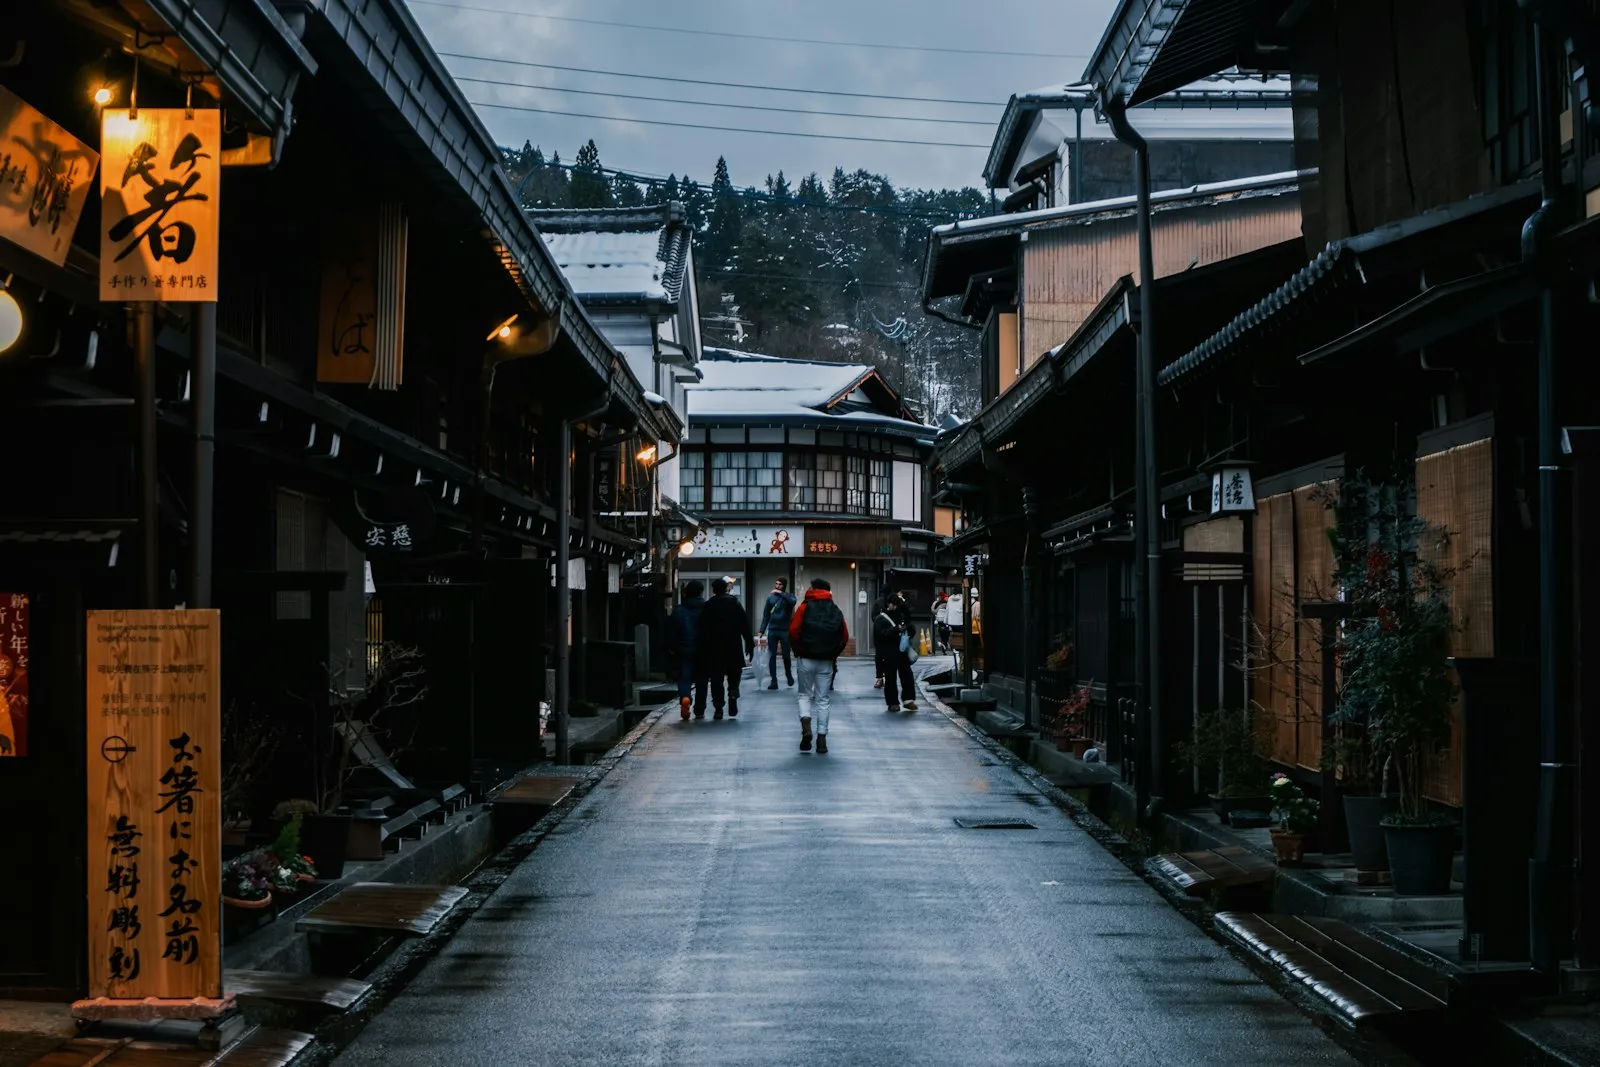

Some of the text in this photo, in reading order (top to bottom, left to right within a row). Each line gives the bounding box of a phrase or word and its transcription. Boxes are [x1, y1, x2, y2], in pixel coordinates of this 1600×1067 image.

[109, 132, 212, 264] 箸
[108, 274, 208, 289] 手作り箸専門店
[10, 593, 28, 667] 新しい年を
[105, 816, 144, 982] 無料彫刻
[156, 732, 204, 966] お箸にお名前
